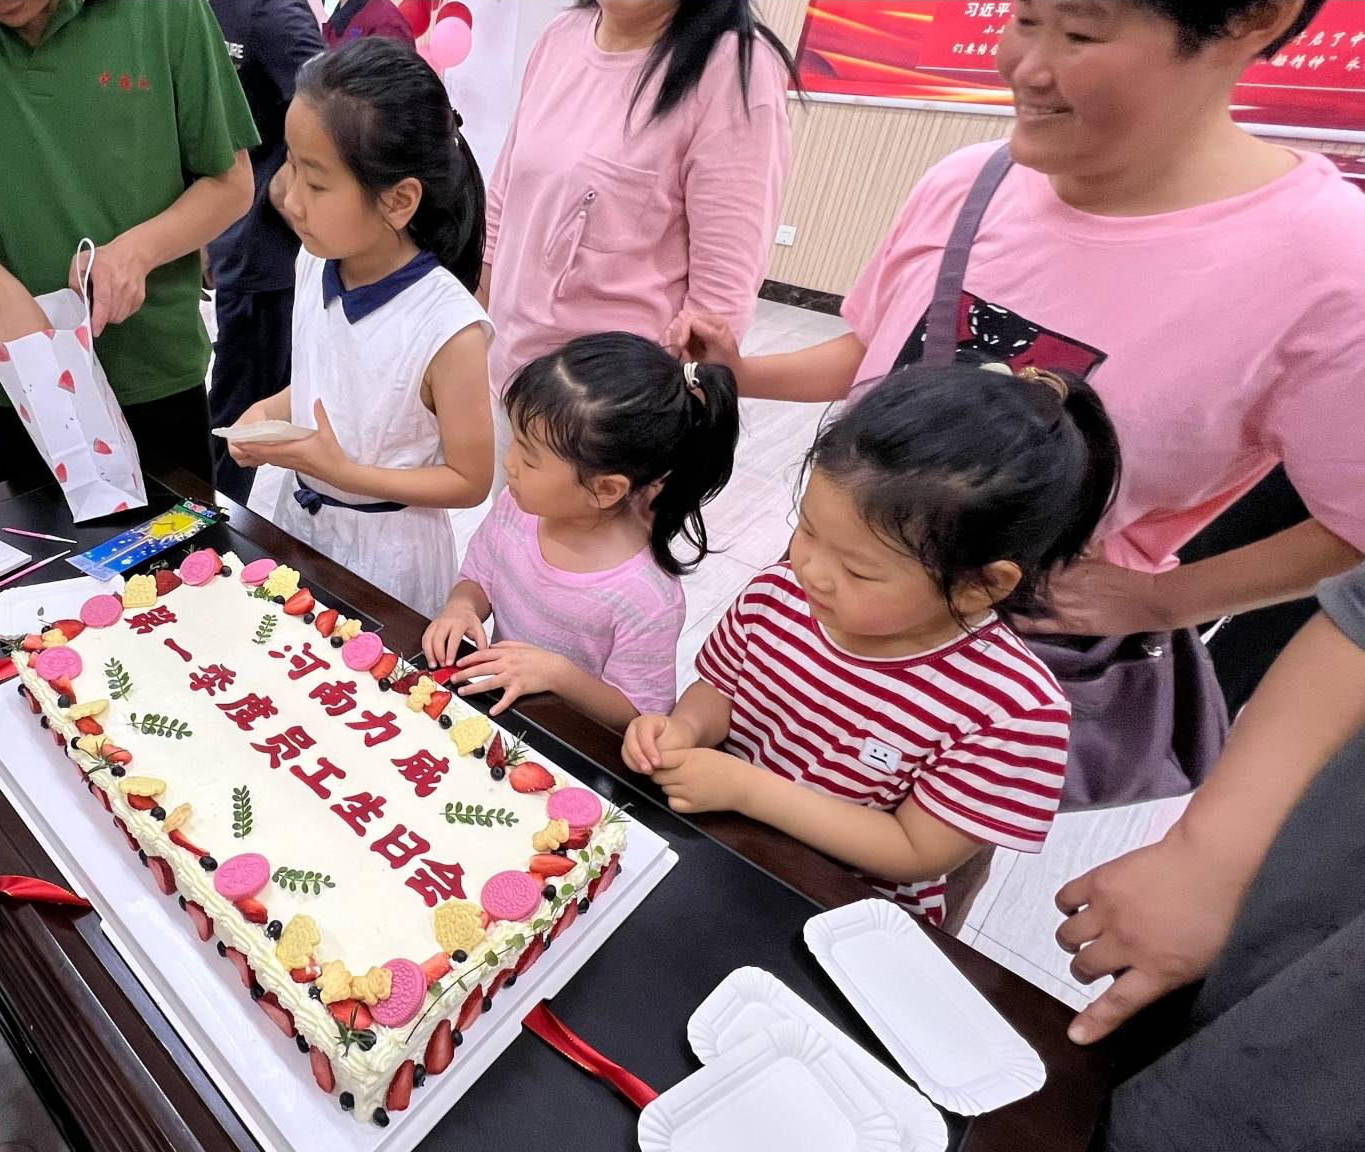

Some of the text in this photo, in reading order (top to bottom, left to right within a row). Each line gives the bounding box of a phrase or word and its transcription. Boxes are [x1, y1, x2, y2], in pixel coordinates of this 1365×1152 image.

[964, 2, 1012, 18] 习近平
[123, 605, 469, 908] 第一季度员工生日会
[267, 641, 451, 800] 河南力威
